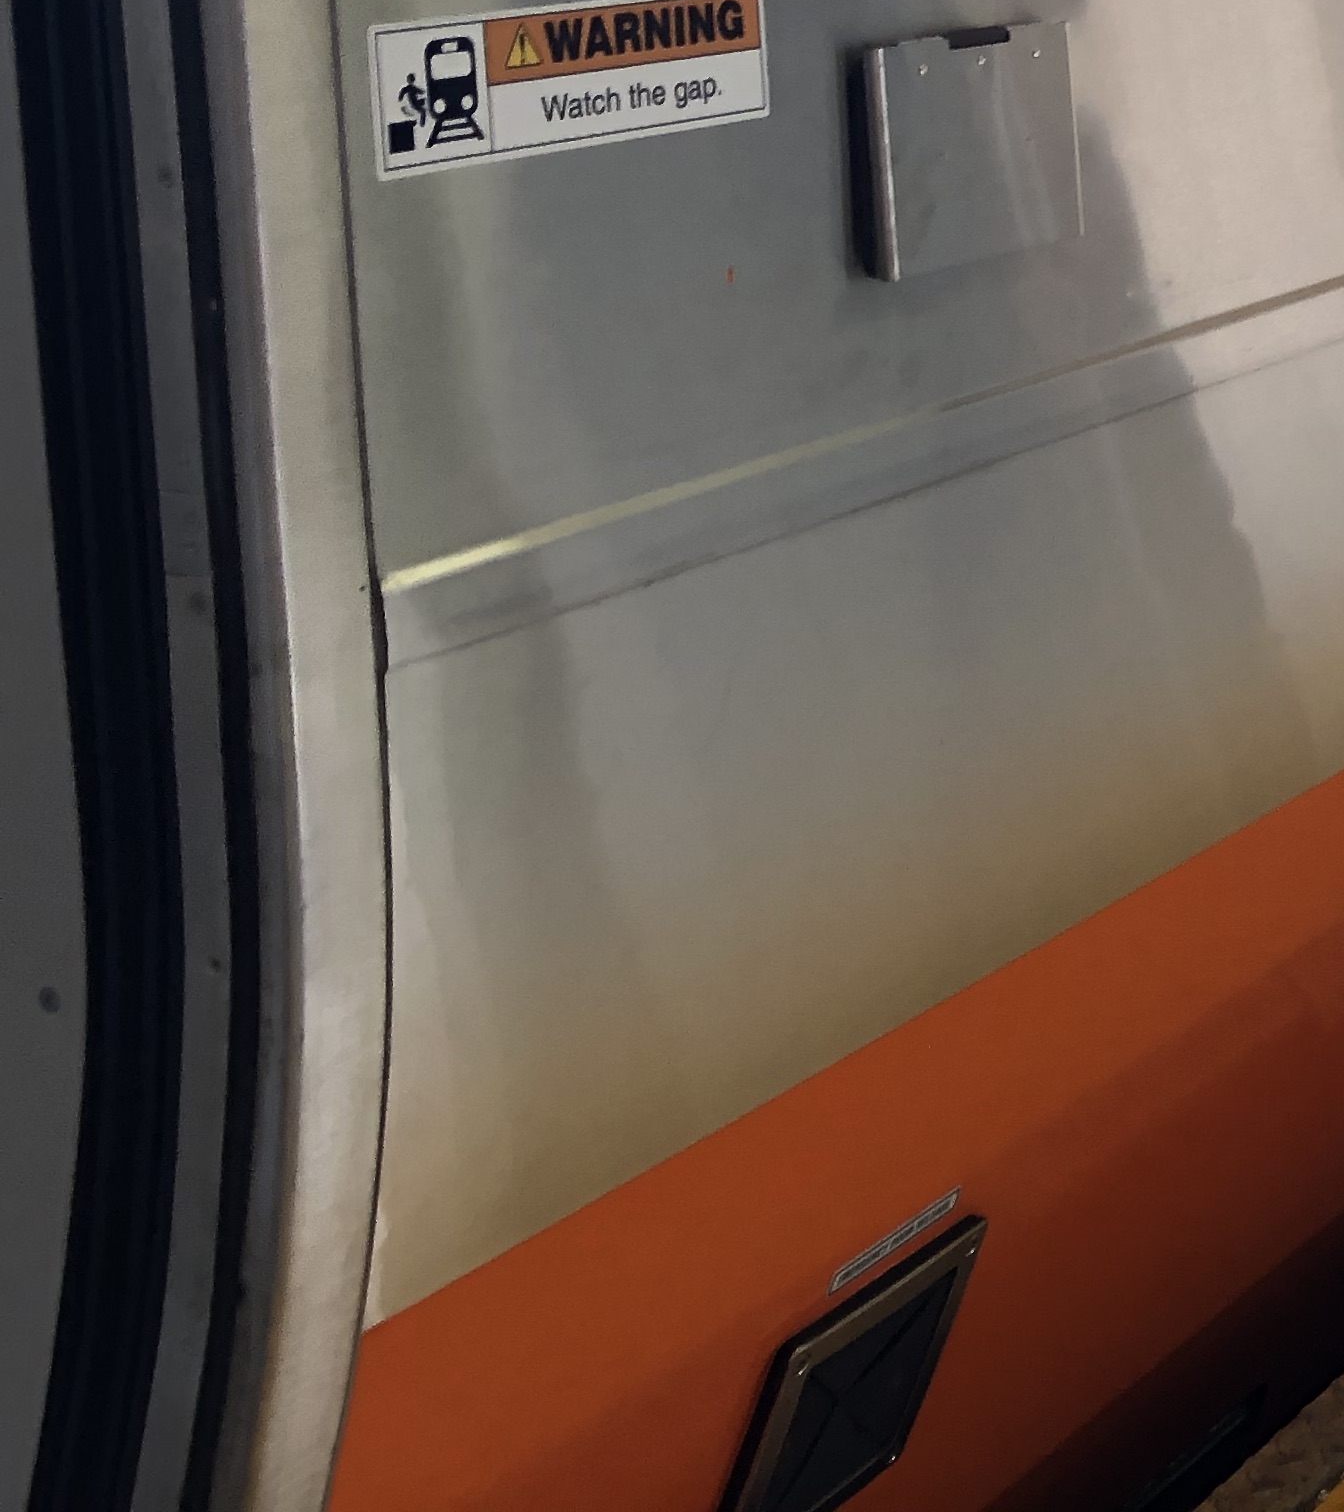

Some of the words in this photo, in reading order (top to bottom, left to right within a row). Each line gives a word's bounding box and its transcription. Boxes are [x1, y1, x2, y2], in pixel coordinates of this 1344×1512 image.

[543, 0, 744, 63] WARNING
[541, 86, 621, 122] Watch
[629, 82, 667, 110] the
[674, 77, 722, 109] gap.
